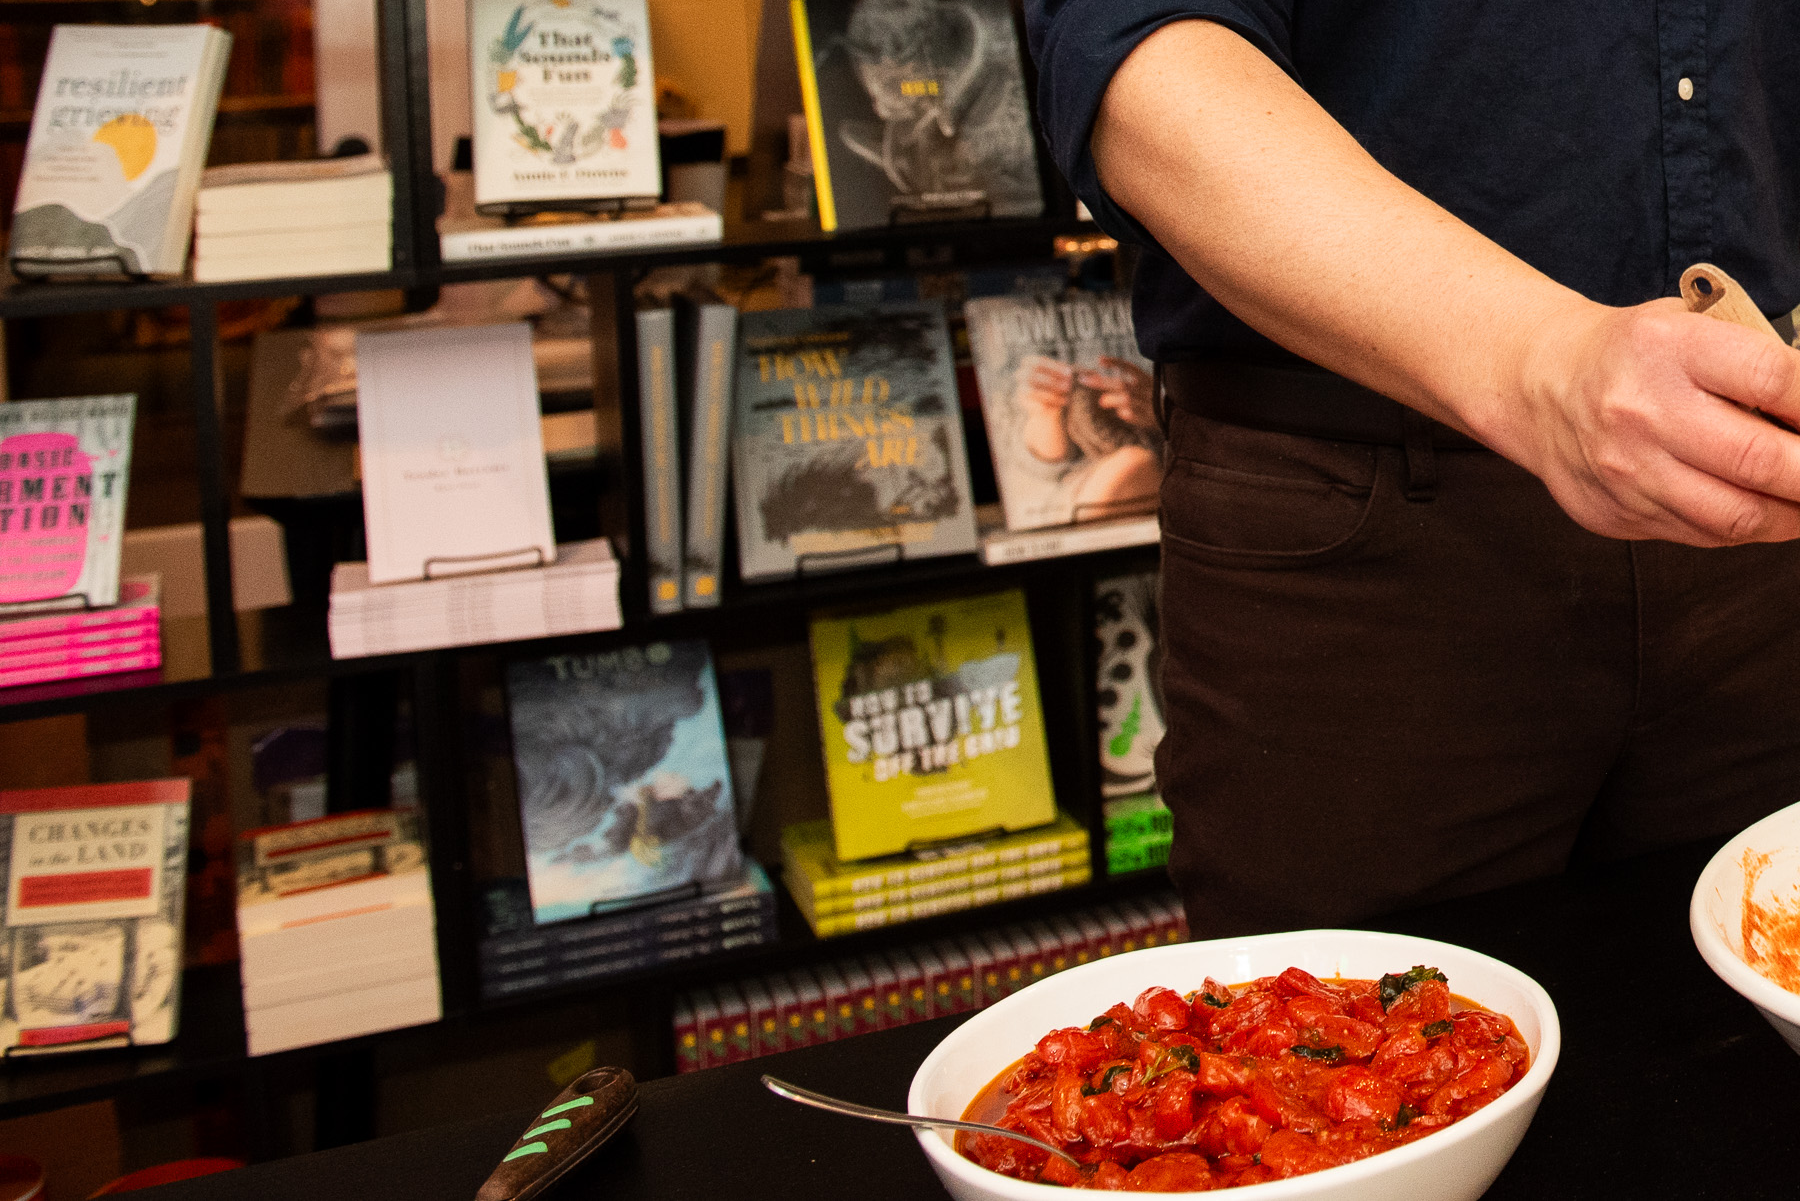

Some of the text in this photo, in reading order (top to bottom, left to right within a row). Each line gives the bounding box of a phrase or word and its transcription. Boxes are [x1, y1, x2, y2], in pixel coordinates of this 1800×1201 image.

[55, 67, 188, 98] resilient
[1060, 301, 1095, 341] TO
[757, 347, 851, 383] HOW
[792, 375, 891, 411] WILD
[773, 405, 918, 445] THINGS
[865, 436, 928, 469] ARE
[850, 678, 933, 718] HOW TO
[843, 679, 1023, 765] SURVIVE
[27, 816, 153, 846] CHANGES
[76, 841, 150, 866] LAND
